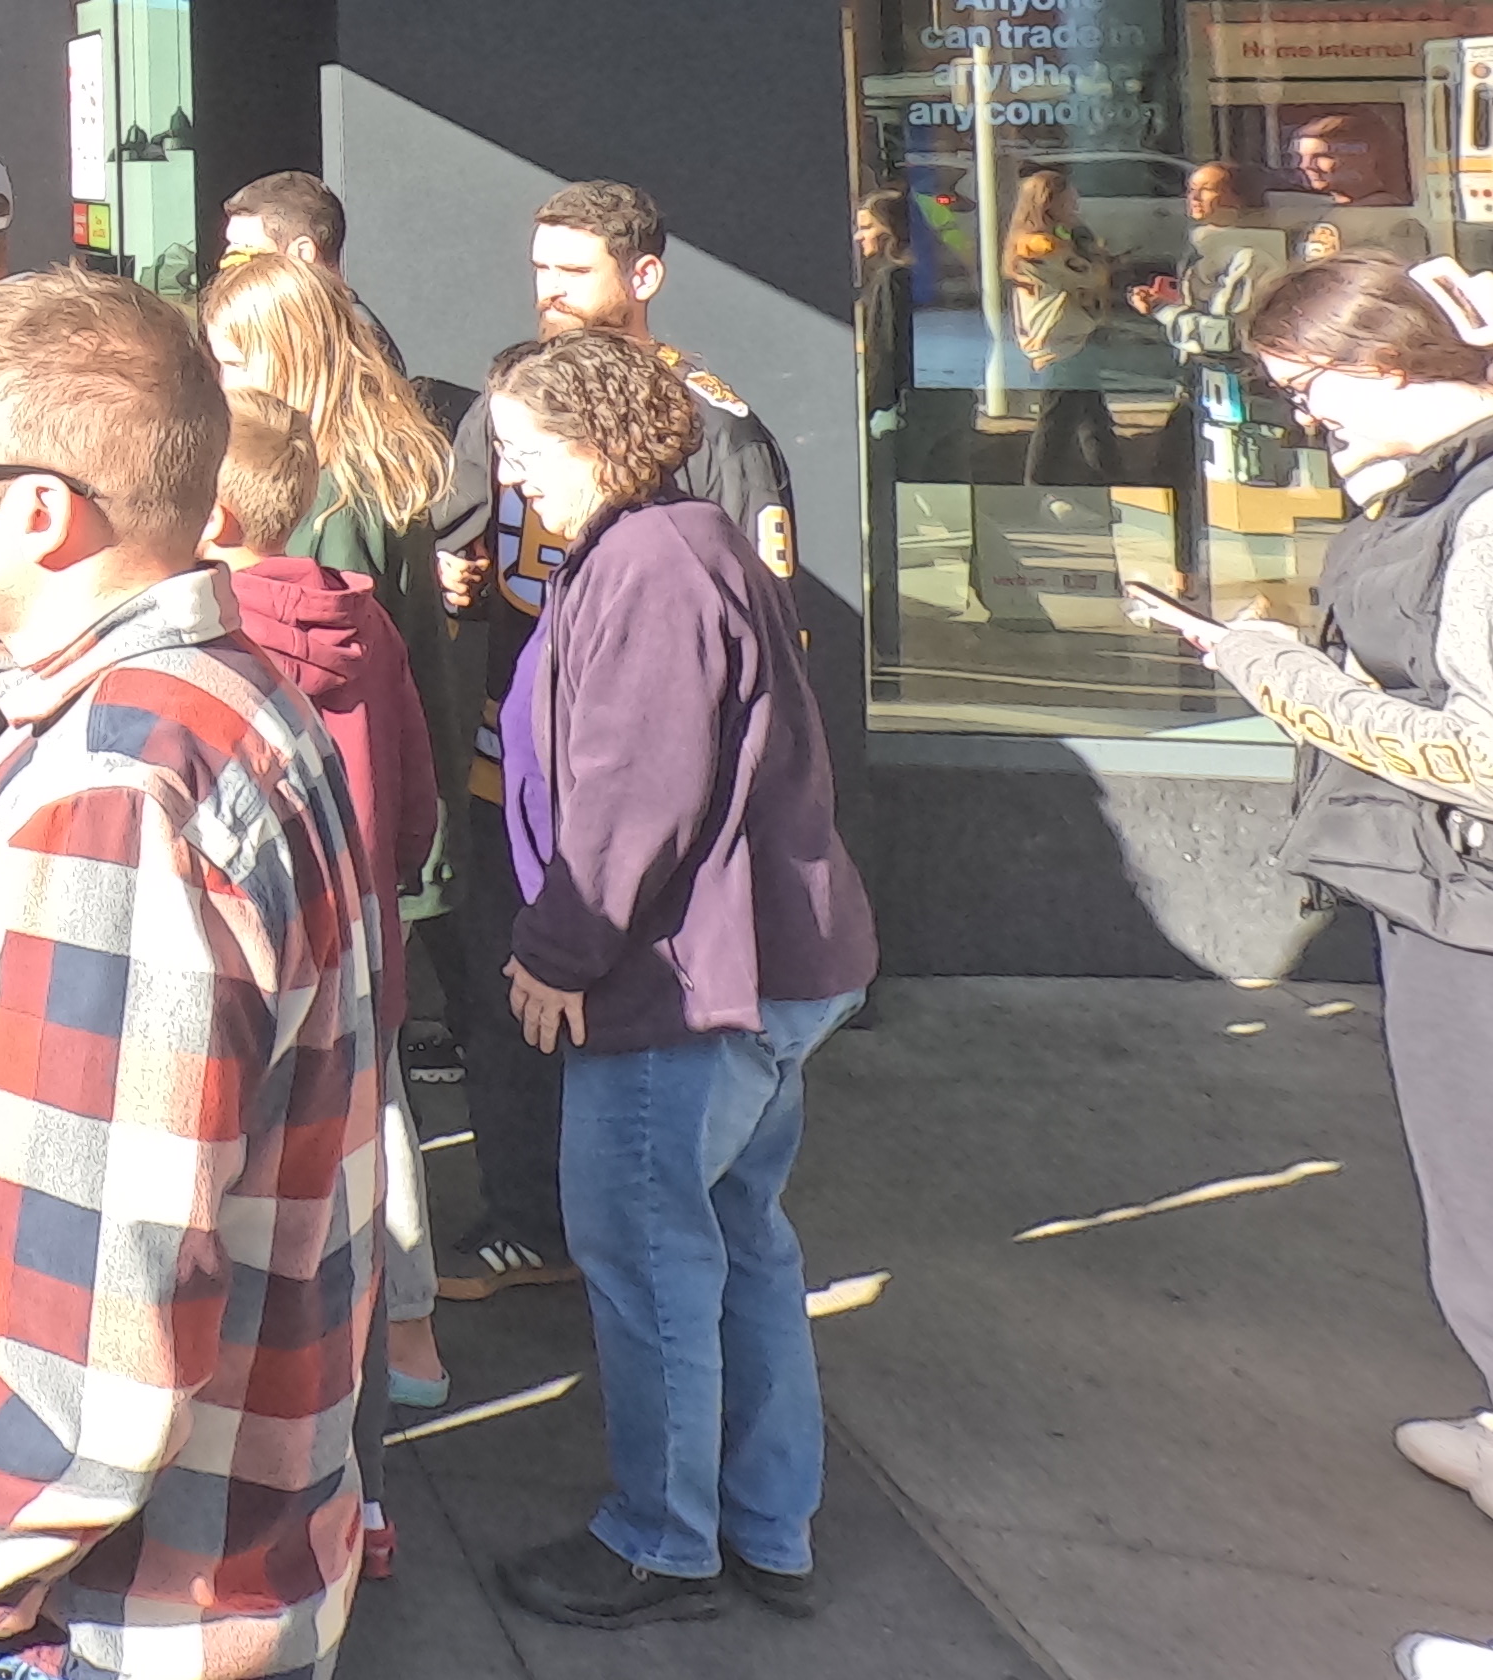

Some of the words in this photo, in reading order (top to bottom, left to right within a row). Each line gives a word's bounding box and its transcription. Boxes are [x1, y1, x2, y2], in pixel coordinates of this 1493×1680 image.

[920, 23, 992, 49] can
[997, 19, 1104, 49] trade
[908, 100, 974, 131] any
